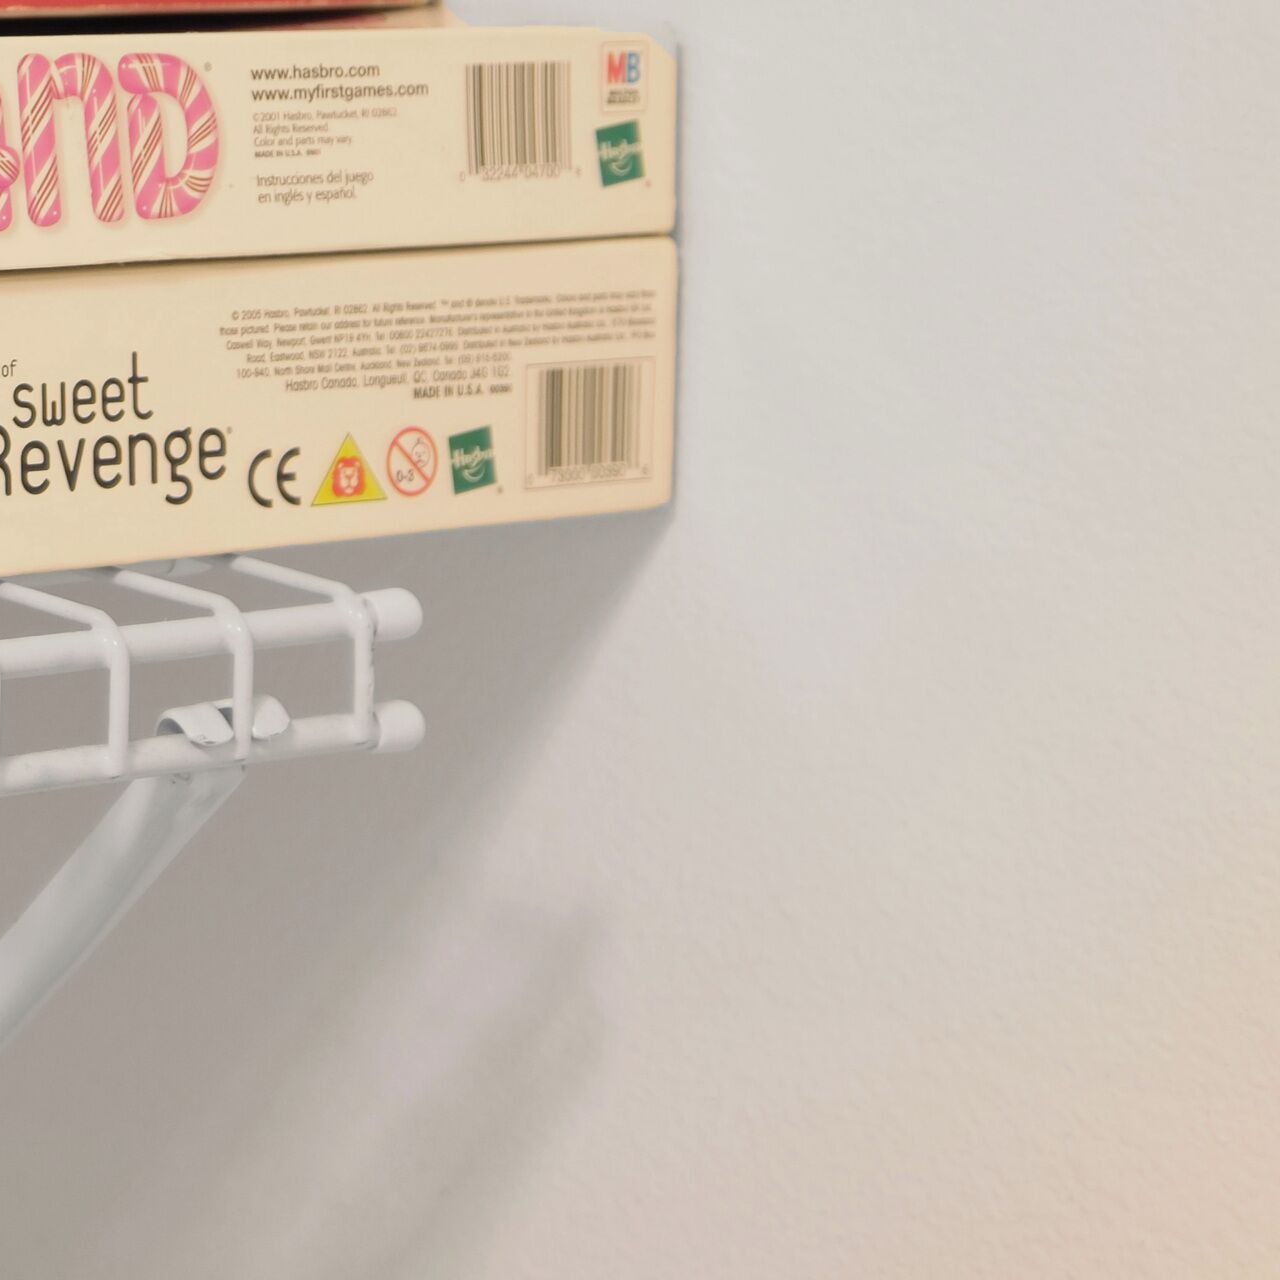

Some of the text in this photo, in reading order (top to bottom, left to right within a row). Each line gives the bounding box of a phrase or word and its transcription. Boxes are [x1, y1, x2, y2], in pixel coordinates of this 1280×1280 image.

[250, 63, 381, 81] www.hasbro.com
[606, 50, 641, 84] MB
[251, 81, 430, 103] www.myfirstgames.com
[253, 124, 263, 135] All
[265, 123, 290, 136] Rights
[254, 136, 275, 147] Color
[278, 135, 293, 146] and
[295, 135, 315, 148] parts
[317, 136, 334, 146] may
[254, 149, 274, 159] MADE
[276, 149, 284, 158] IN
[256, 169, 374, 187] Instrucciones del juego
[258, 192, 272, 204] en
[307, 191, 313, 204] y
[1, 359, 18, 378] of
[413, 385, 441, 399] MADE
[444, 384, 454, 398] IN
[247, 446, 302, 508] CE
